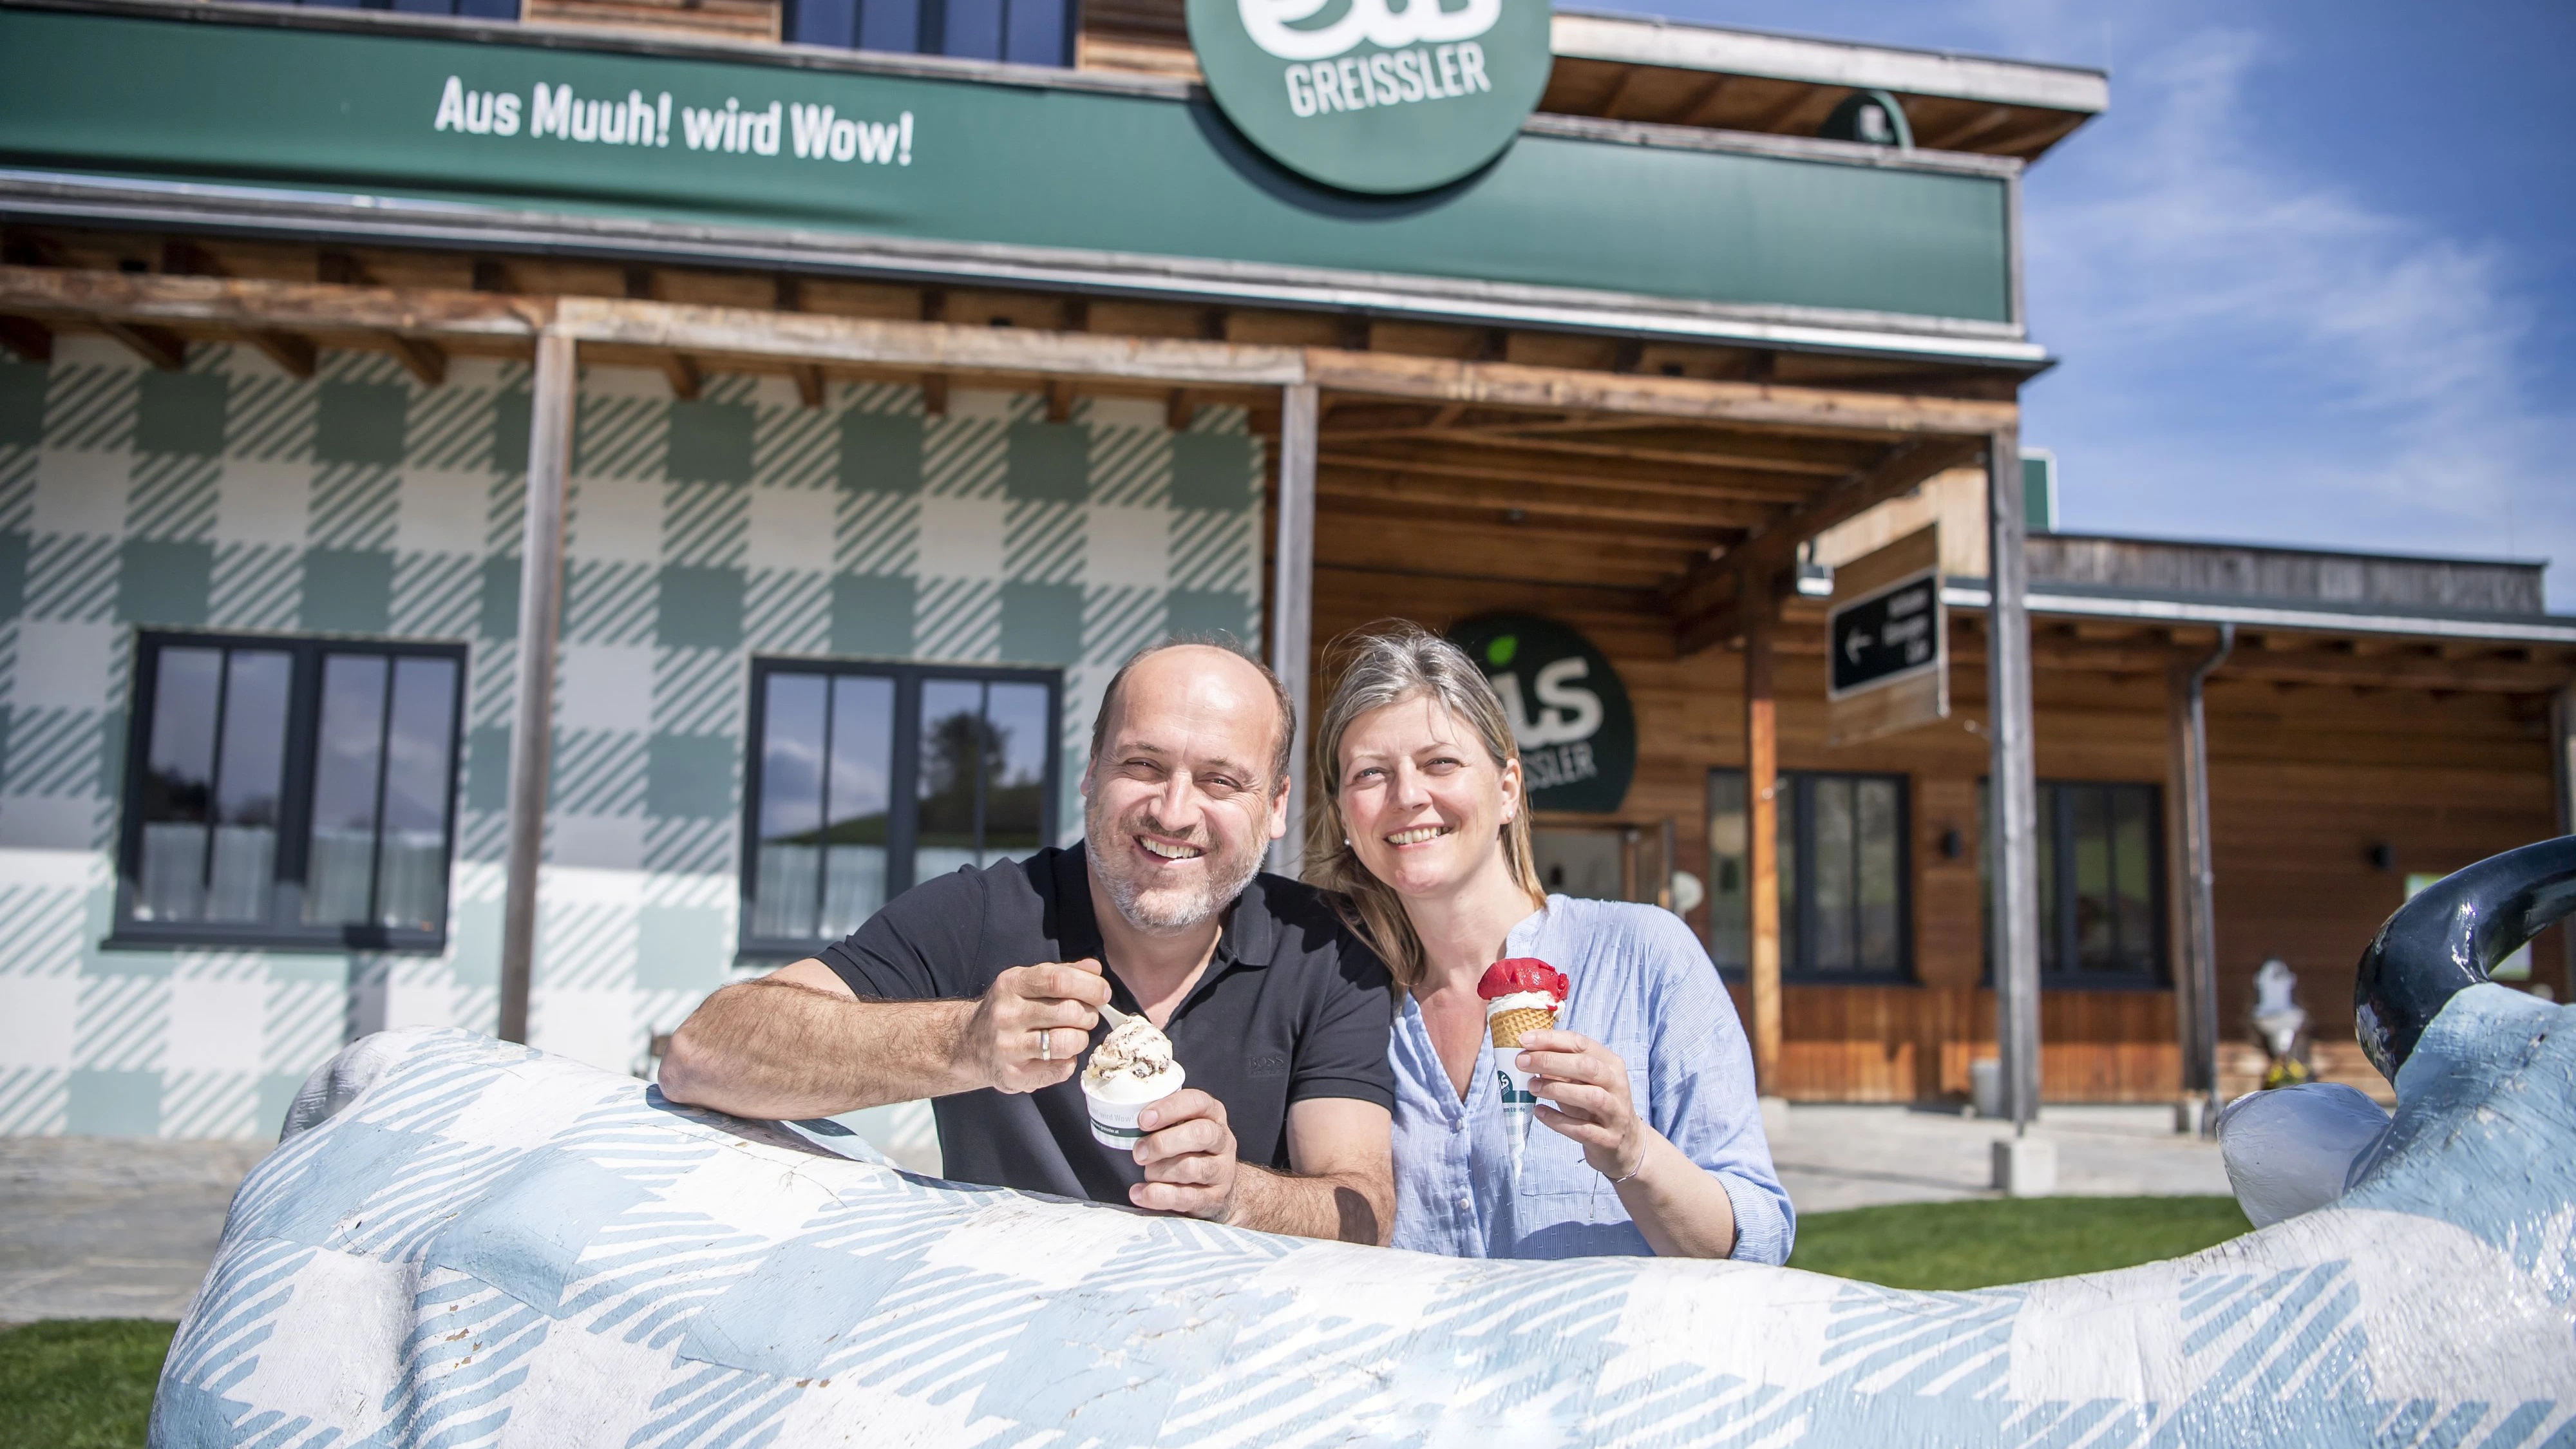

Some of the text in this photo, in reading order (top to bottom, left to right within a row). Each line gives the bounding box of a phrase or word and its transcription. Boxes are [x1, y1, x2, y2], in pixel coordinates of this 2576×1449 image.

[1284, 41, 1492, 118] GREISSLER
[434, 75, 914, 167] Aus Muuh! wird Wow!
[1246, 1054, 1285, 1068] BOSS
[1100, 1112, 1134, 1122] wird Wow!
